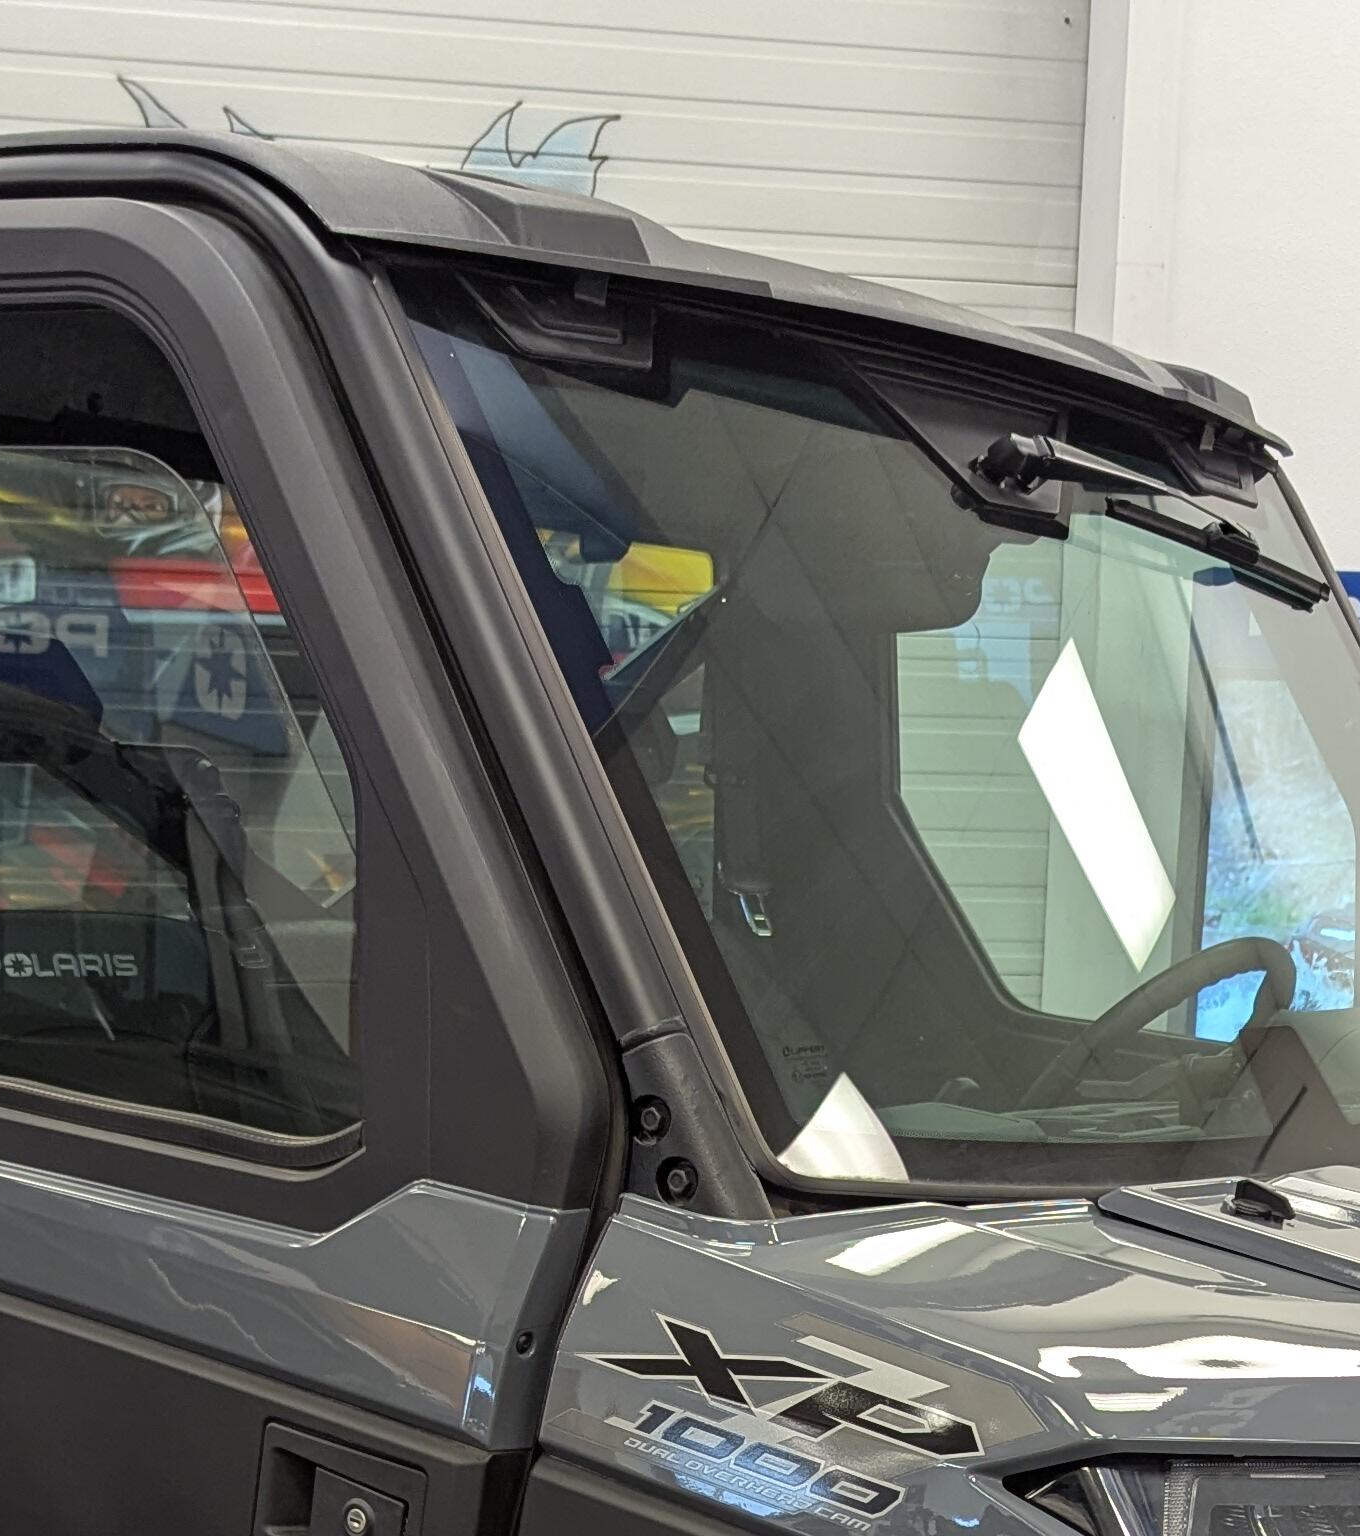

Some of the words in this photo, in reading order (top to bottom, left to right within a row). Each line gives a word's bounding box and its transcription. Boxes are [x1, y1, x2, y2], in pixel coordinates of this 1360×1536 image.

[575, 1310, 986, 1459] XP
[623, 1437, 681, 1464] DUAL
[685, 1460, 813, 1510] OVERHEAD
[814, 1507, 873, 1532] CAM
[631, 1399, 906, 1519] 1000
